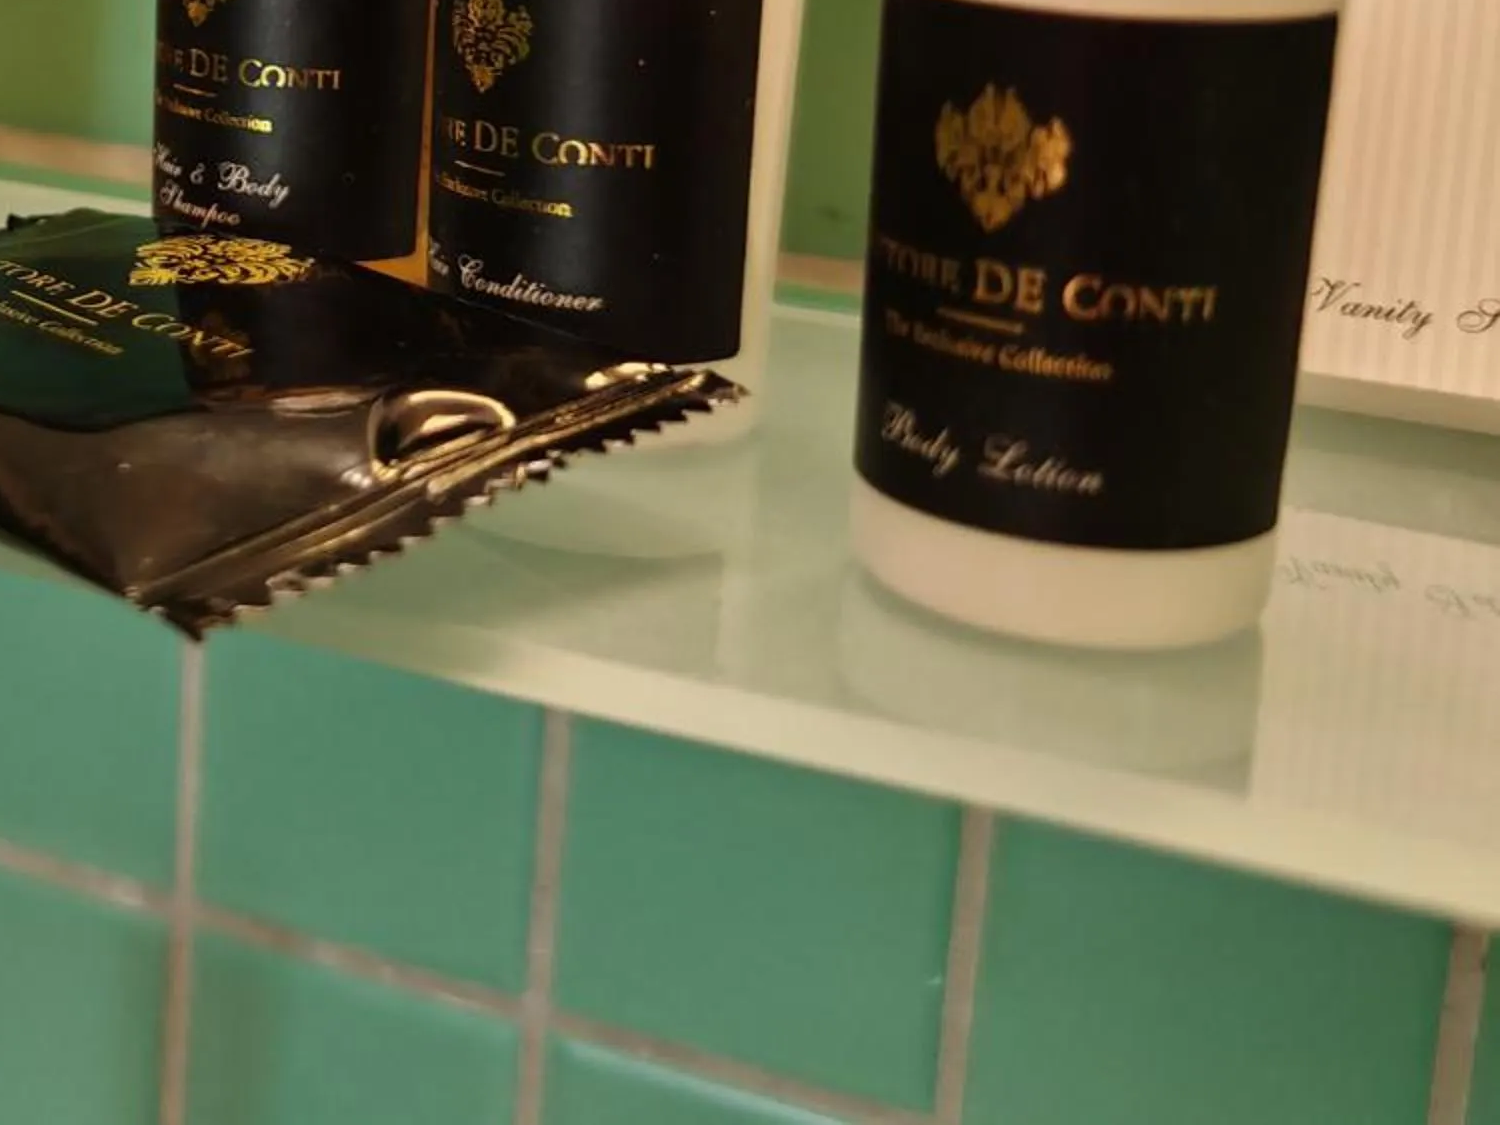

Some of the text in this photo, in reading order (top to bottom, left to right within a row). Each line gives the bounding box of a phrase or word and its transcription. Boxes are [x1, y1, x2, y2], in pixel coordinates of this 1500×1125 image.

[189, 47, 230, 84] DE
[237, 58, 342, 90] CONTI
[472, 119, 520, 159] DE
[530, 131, 656, 170] CONTI
[160, 180, 242, 230] Shampoo
[217, 161, 290, 210] Body
[457, 253, 606, 312] Conditioner
[972, 256, 1048, 315] DE
[1062, 271, 1219, 323] CONTI
[1311, 276, 1434, 342] Vanity
[65, 289, 139, 319] DE
[131, 312, 256, 359] CONTI
